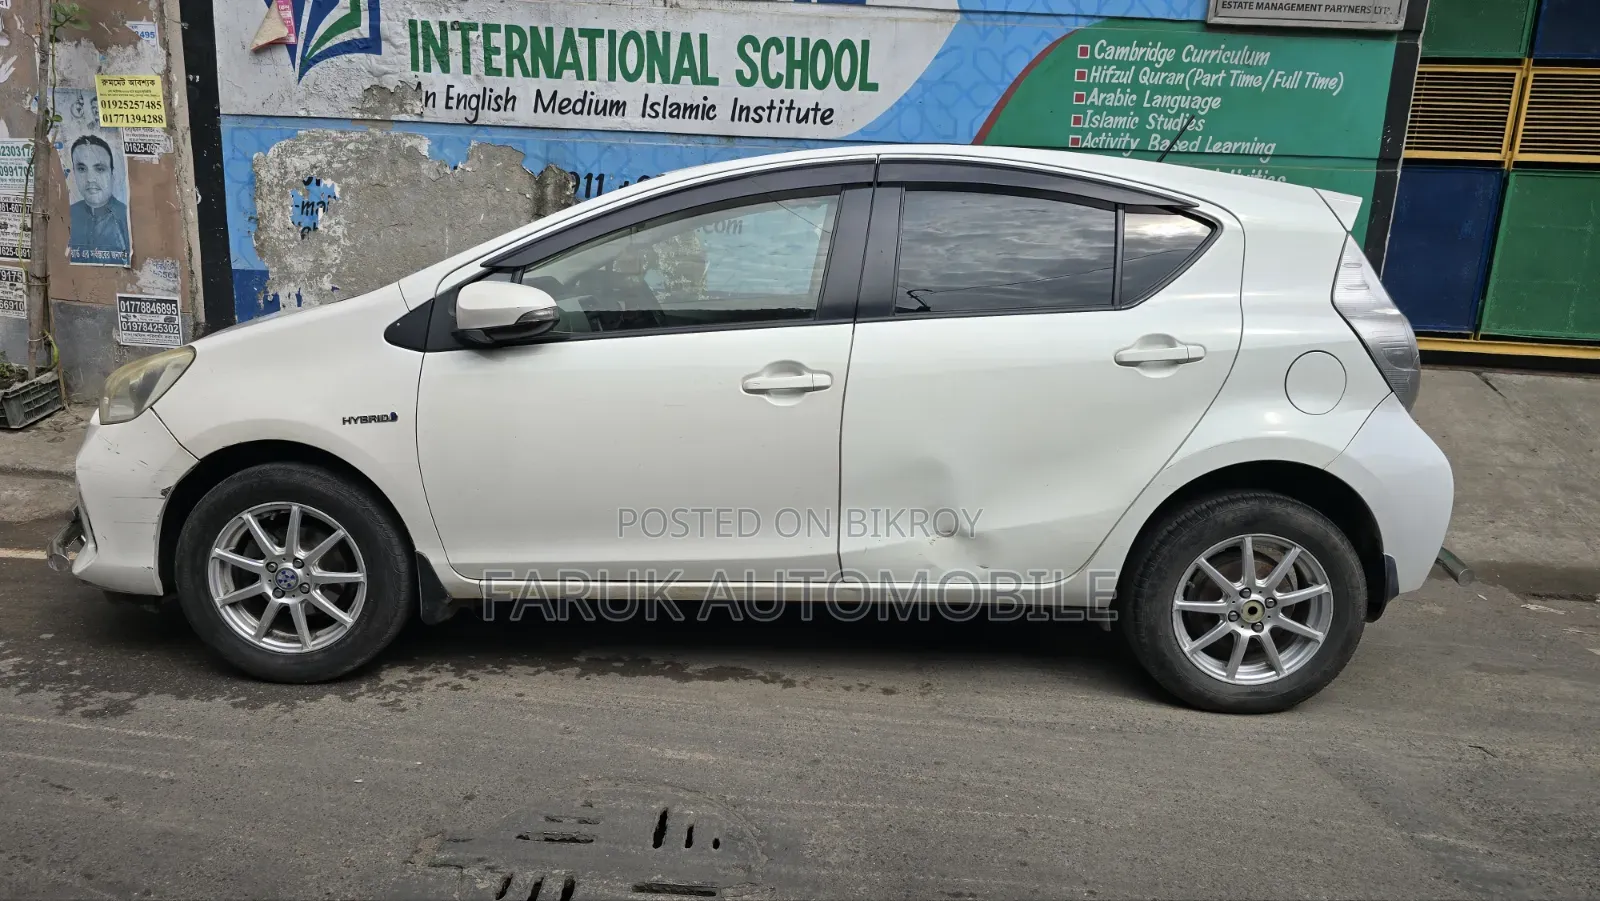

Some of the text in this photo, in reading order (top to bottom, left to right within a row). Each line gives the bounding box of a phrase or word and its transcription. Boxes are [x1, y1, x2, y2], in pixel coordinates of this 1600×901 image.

[1221, 0, 1254, 10] ESTATE
[1255, 2, 1322, 13] MANAGEMENT
[1324, 4, 1372, 14] PARTNERS
[408, 18, 879, 92] INTERNATIONAL SCHOOL
[1094, 40, 1271, 68] Cambridge Curriculum
[1089, 65, 1136, 84] Hifzul
[1304, 71, 1344, 96] Time)
[100, 99, 162, 110] 01925257485
[444, 84, 517, 124] English
[533, 88, 627, 117] Medium
[641, 93, 717, 121] Islamic
[730, 97, 834, 126] Institute
[1086, 88, 1222, 115] Arabic Language
[102, 113, 164, 124] 01771394288
[1082, 110, 1205, 131] Islamic Studies
[1081, 132, 1276, 163] Activity Based Learning
[120, 300, 177, 315] 01778846895
[122, 321, 179, 334] 01978425302
[342, 414, 389, 425] HYBRID
